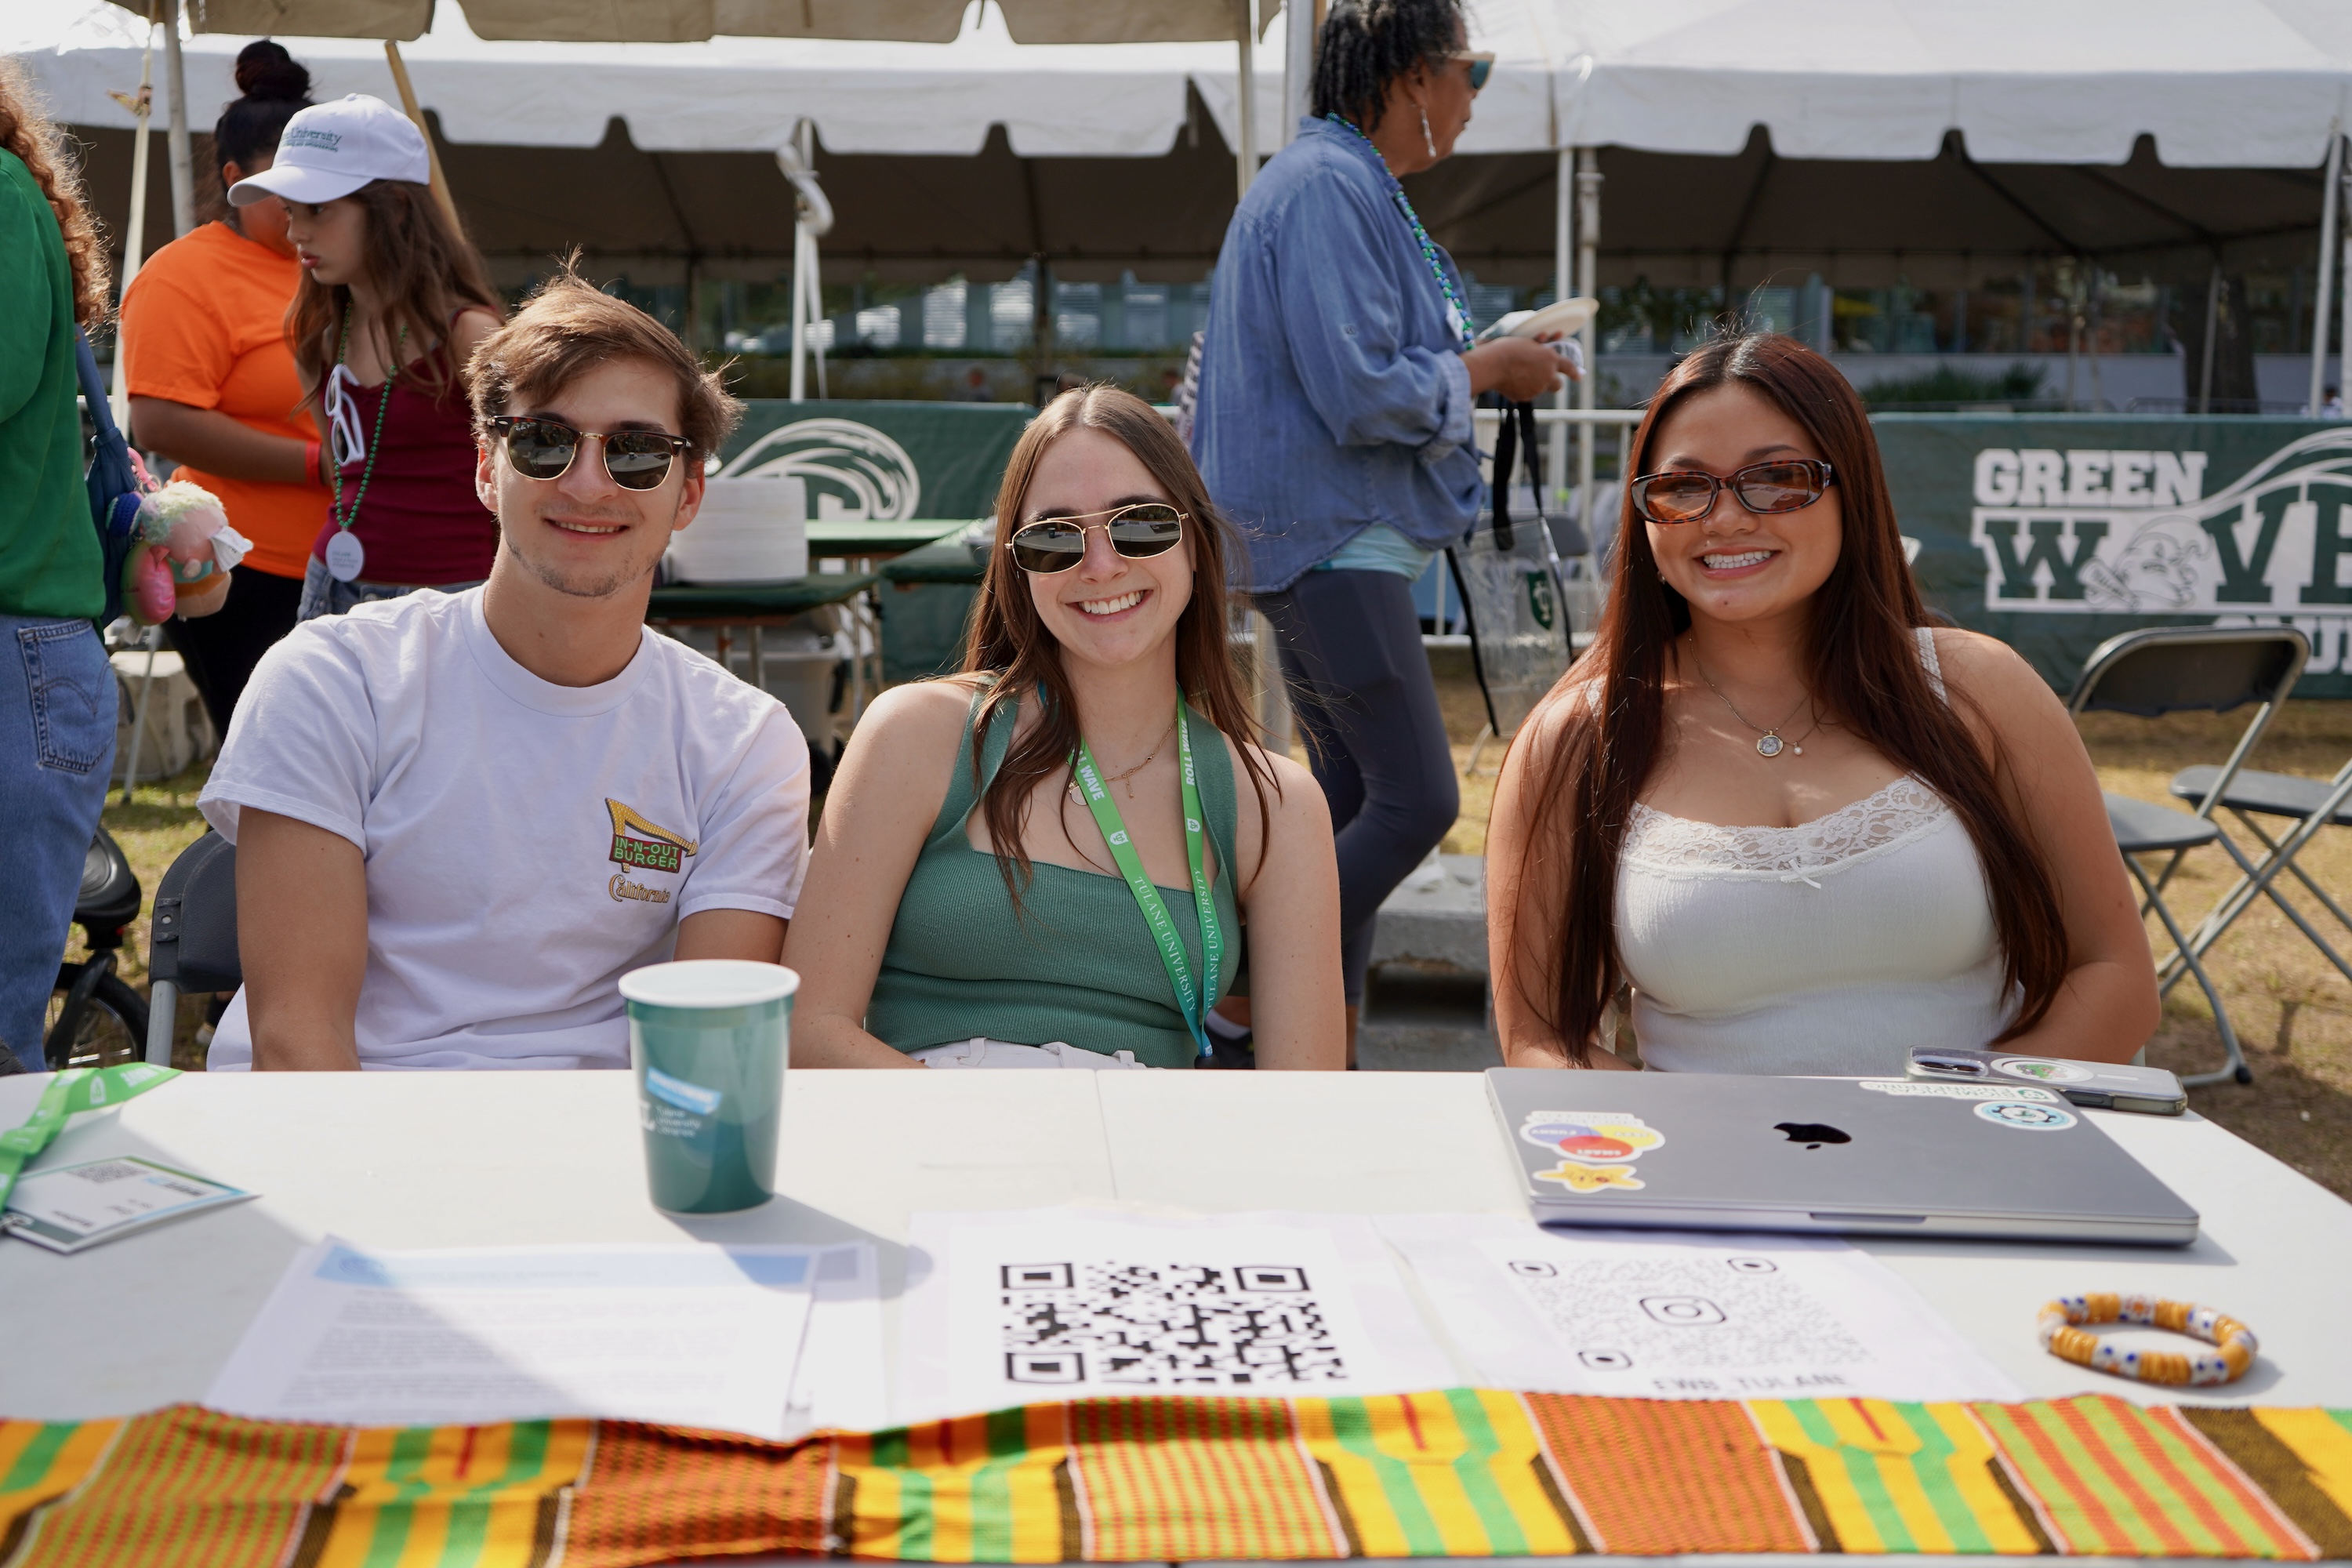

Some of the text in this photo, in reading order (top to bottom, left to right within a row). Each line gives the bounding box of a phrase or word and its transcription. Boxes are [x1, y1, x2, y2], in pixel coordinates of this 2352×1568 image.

[291, 126, 343, 146] University
[1973, 448, 2209, 506] GREEN
[1181, 717, 1196, 786] ROLL WAVE
[1080, 764, 1105, 801] WAVE
[614, 848, 678, 869] BURGER
[615, 837, 679, 858] IN-N-OUT
[608, 873, 671, 903] California
[1134, 876, 1196, 1012] TULANE UNIVERSITY
[1193, 866, 1219, 1012] TULANE UNIVERSITY
